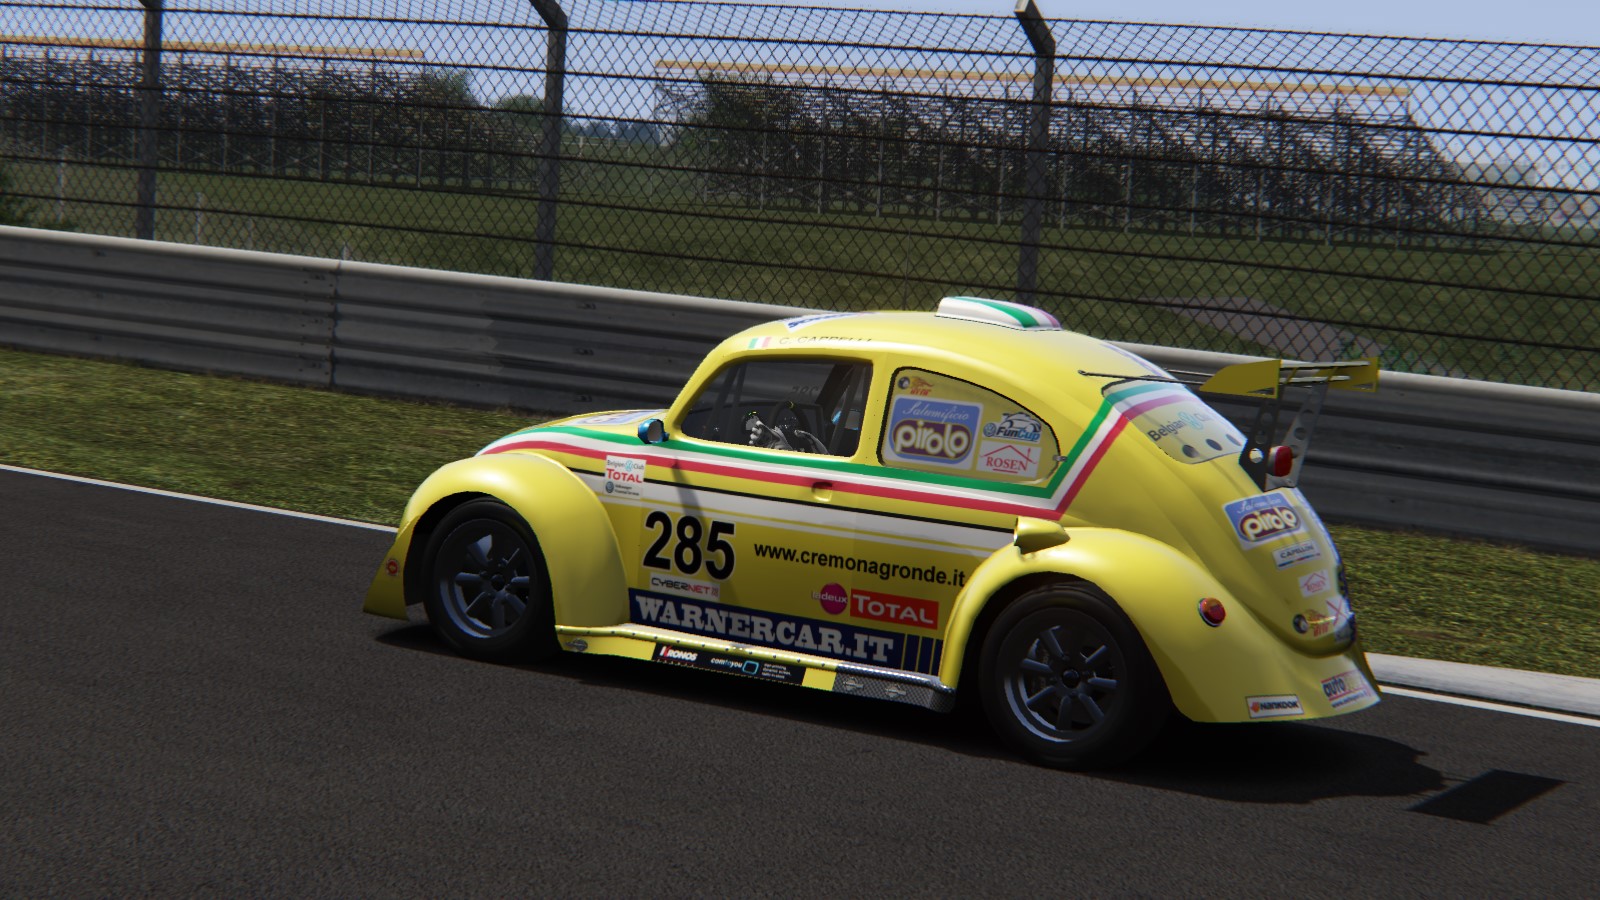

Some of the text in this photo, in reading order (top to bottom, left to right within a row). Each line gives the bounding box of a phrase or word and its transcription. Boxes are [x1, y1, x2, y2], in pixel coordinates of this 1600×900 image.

[902, 402, 970, 425] Salumificio
[894, 419, 970, 458] pirolo
[995, 428, 1041, 442] FunCup
[1147, 418, 1187, 442] Belgian
[606, 468, 643, 483] TOTAL
[985, 454, 1029, 472] ROSEN
[1242, 506, 1298, 541] pirolo
[643, 510, 735, 580] 285
[754, 543, 966, 588] www.cremonagronde.it
[651, 577, 710, 595] CYBERNET
[852, 593, 934, 624] TOTAL
[634, 595, 894, 663] WARNERCAR.IT
